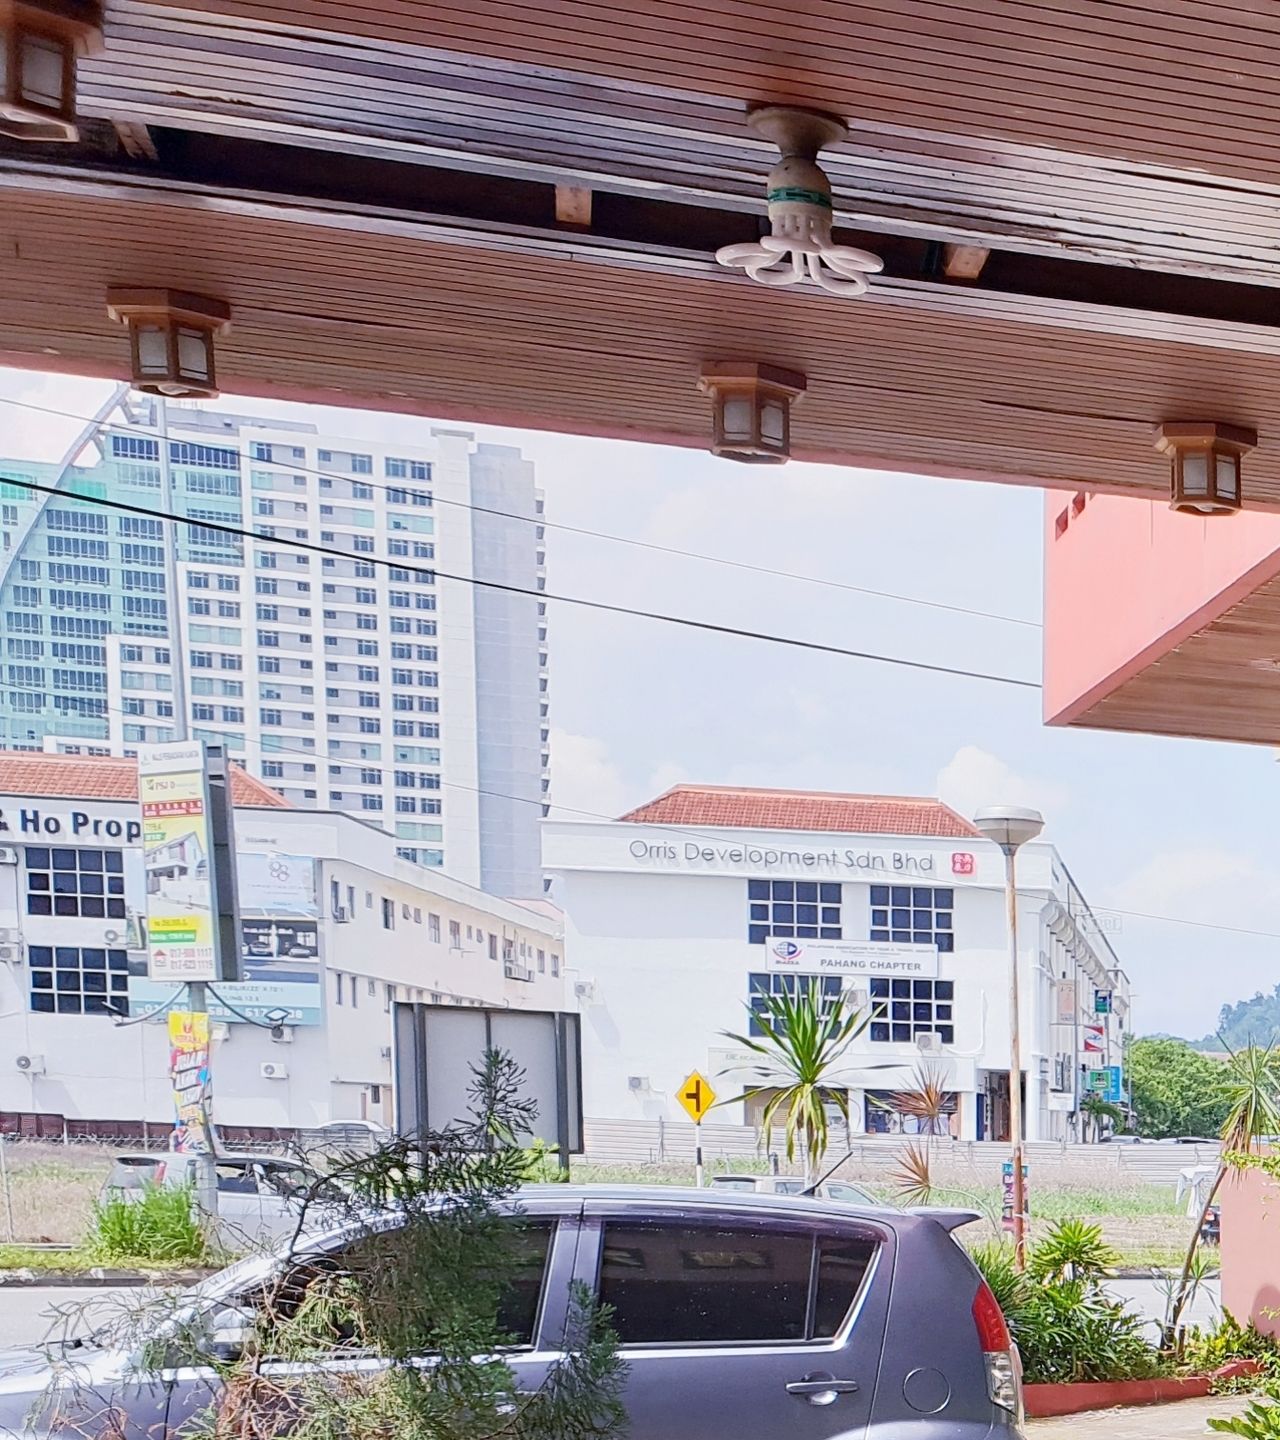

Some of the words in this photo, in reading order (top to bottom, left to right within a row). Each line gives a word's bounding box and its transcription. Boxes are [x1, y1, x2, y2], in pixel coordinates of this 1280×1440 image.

[20, 809, 61, 834] Ho
[629, 840, 677, 861] Orris
[684, 841, 838, 868] Development
[844, 850, 885, 869] Sdn
[893, 851, 934, 872] Bhd
[820, 958, 867, 969] PAHANG
[869, 960, 922, 971] CHAPTER
